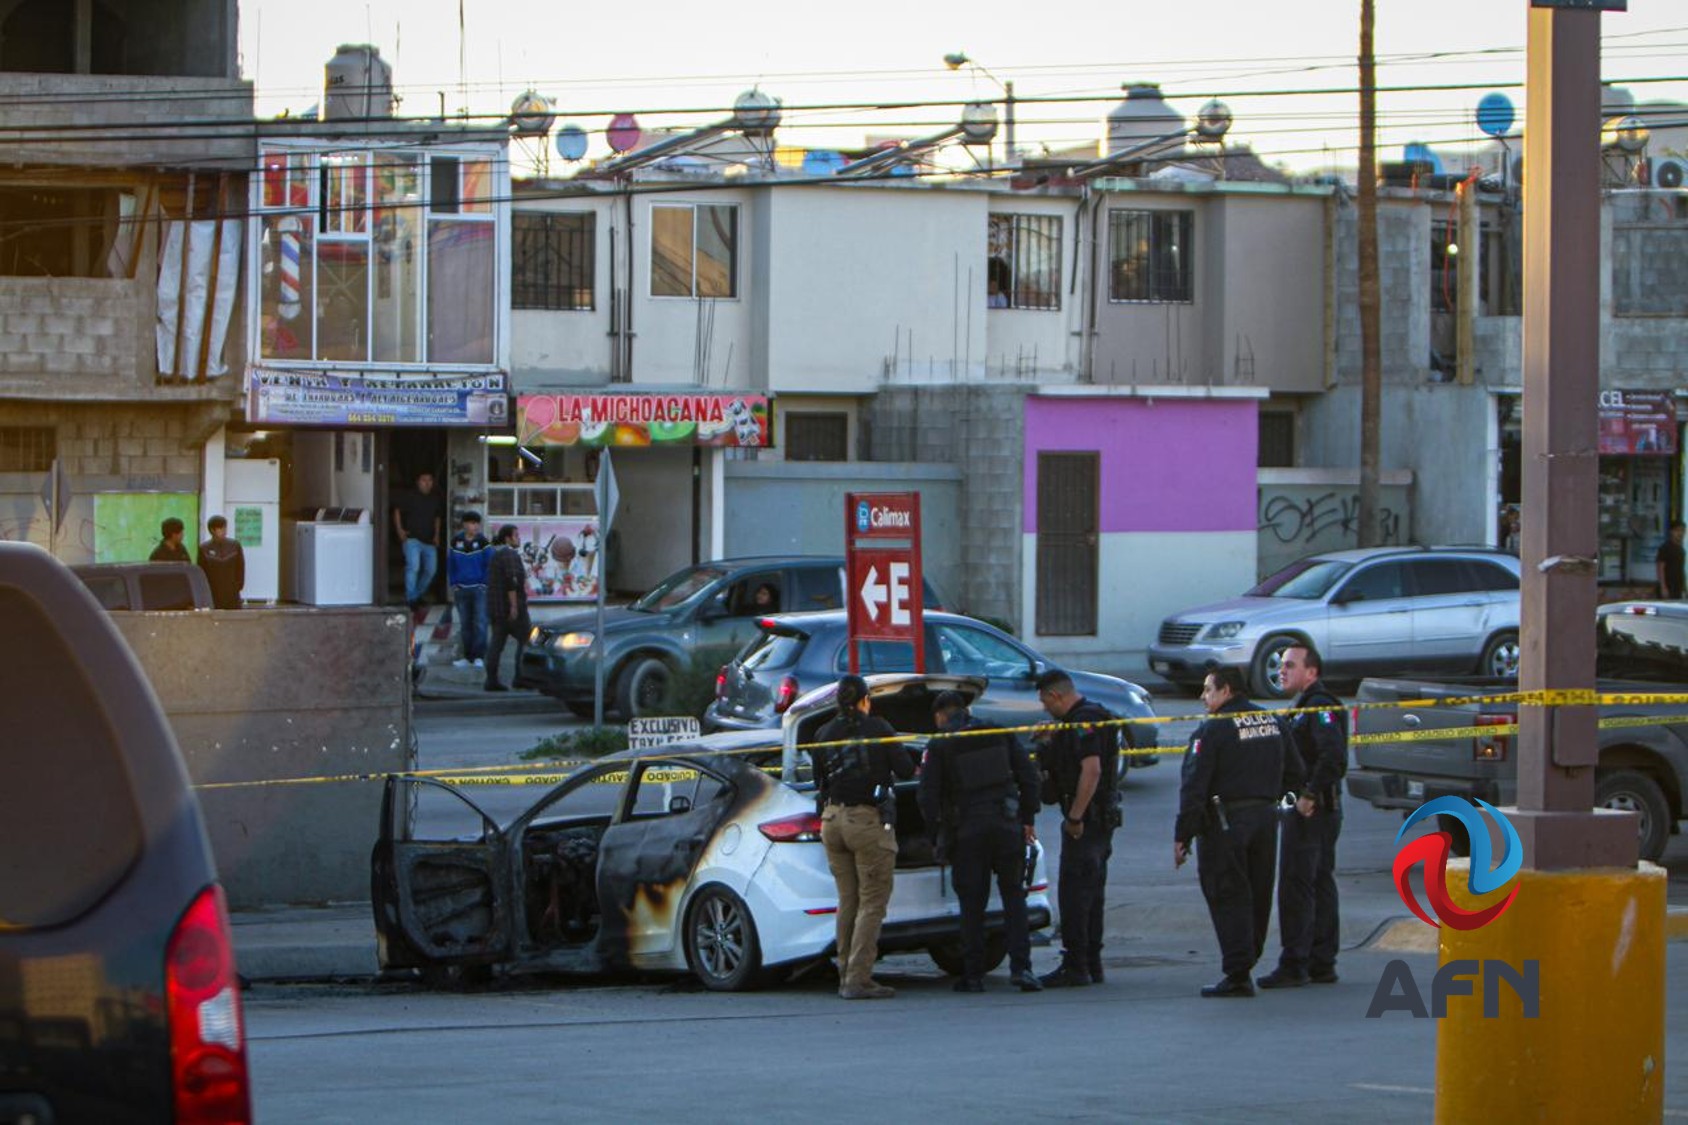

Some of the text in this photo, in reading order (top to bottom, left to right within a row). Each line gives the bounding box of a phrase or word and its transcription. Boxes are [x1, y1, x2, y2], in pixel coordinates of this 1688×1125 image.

[260, 374, 328, 388] VENTA
[340, 377, 352, 388] Y
[1597, 390, 1625, 408] CEL
[557, 397, 724, 423] LA MICHOACANA
[871, 506, 911, 527] Calimax
[890, 562, 911, 625] E
[630, 719, 699, 735] EXCLUSIVO
[1233, 714, 1279, 727] POLICIA
[1239, 724, 1281, 740] MUNICIPAL
[647, 770, 693, 782] CUIDADO
